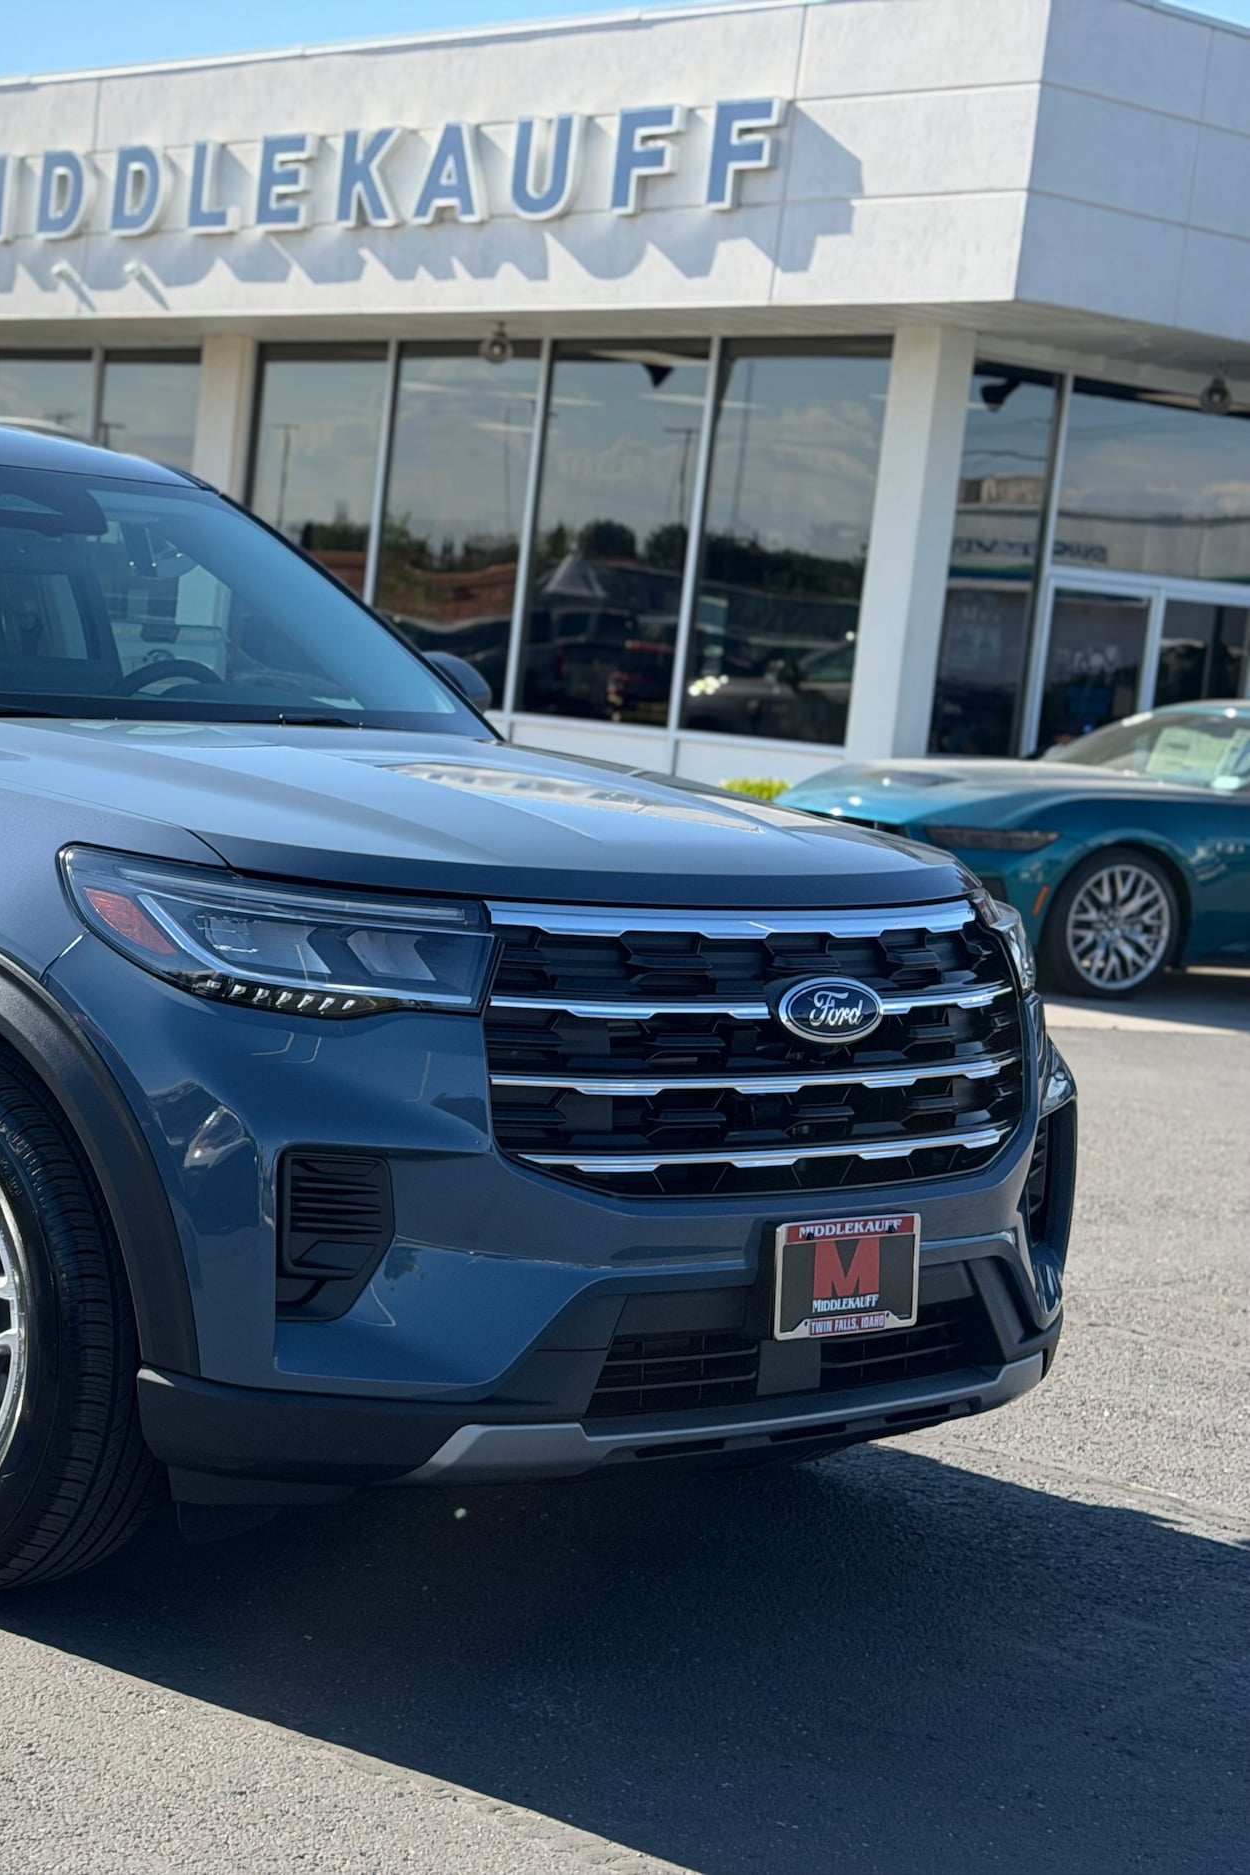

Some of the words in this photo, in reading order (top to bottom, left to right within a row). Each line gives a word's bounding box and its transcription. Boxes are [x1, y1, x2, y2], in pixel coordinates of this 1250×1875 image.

[809, 990, 864, 1027] Ford
[814, 1237, 880, 1298] M
[812, 1293, 880, 1313] MIDDLEKAUFF
[811, 1319, 833, 1334] TWIN
[861, 1314, 885, 1328] IDAHO
